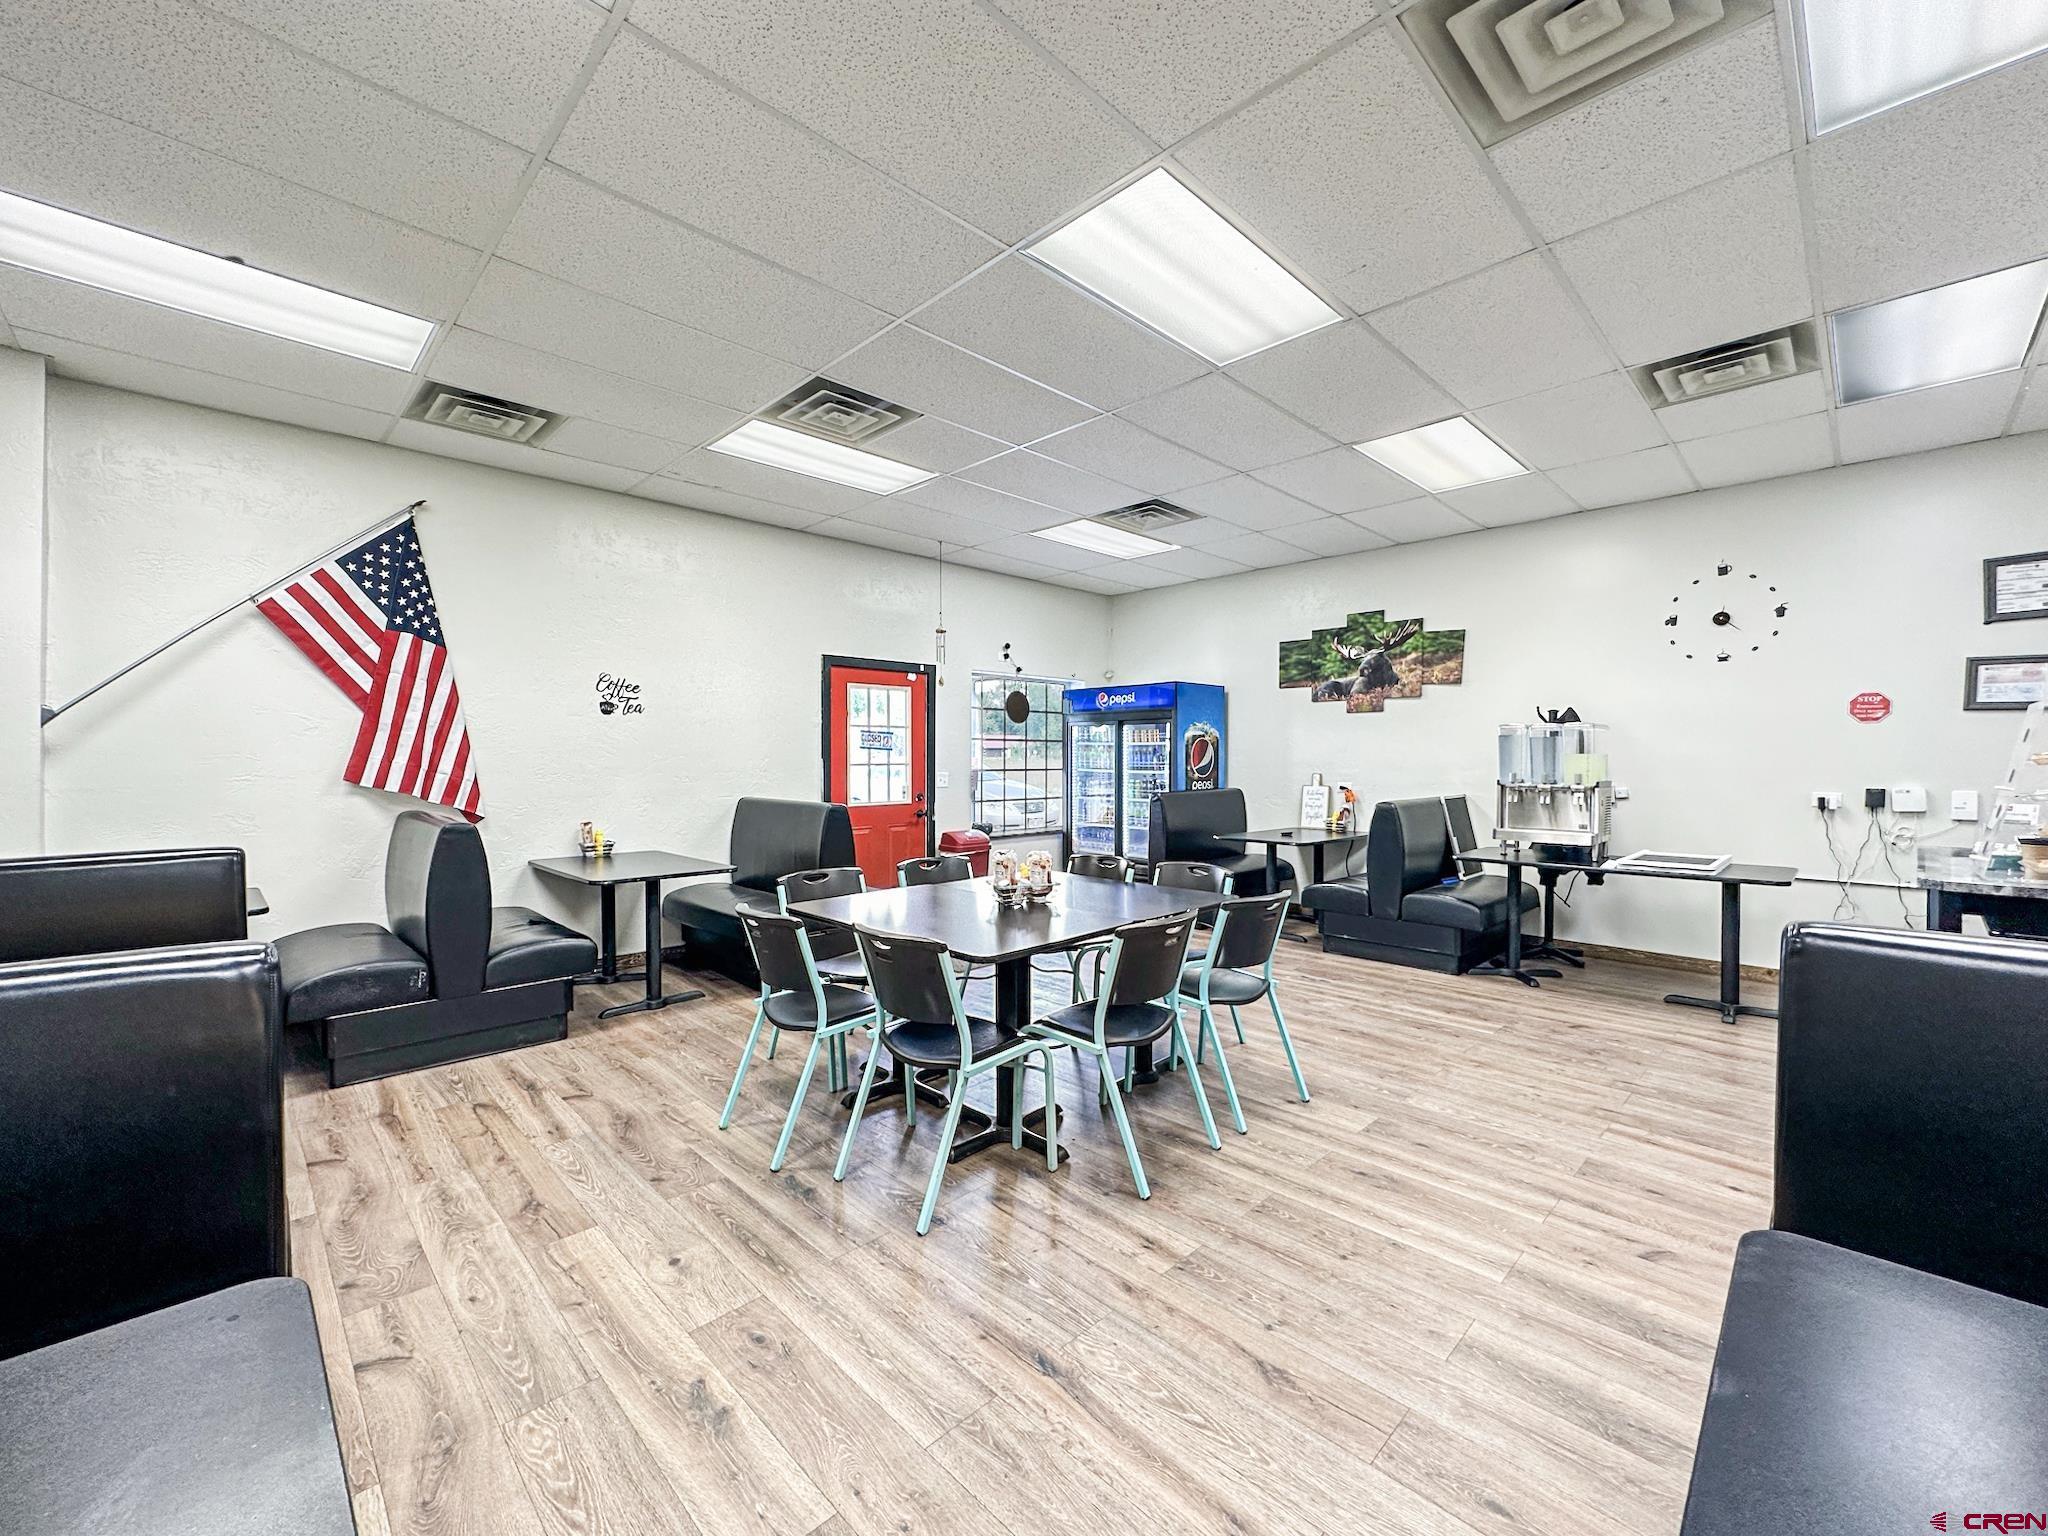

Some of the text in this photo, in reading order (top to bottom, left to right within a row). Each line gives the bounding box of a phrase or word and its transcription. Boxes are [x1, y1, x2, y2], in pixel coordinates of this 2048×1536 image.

[596, 672, 641, 698] Coffee
[618, 696, 645, 716] Tea
[1109, 691, 1136, 706] pepsi
